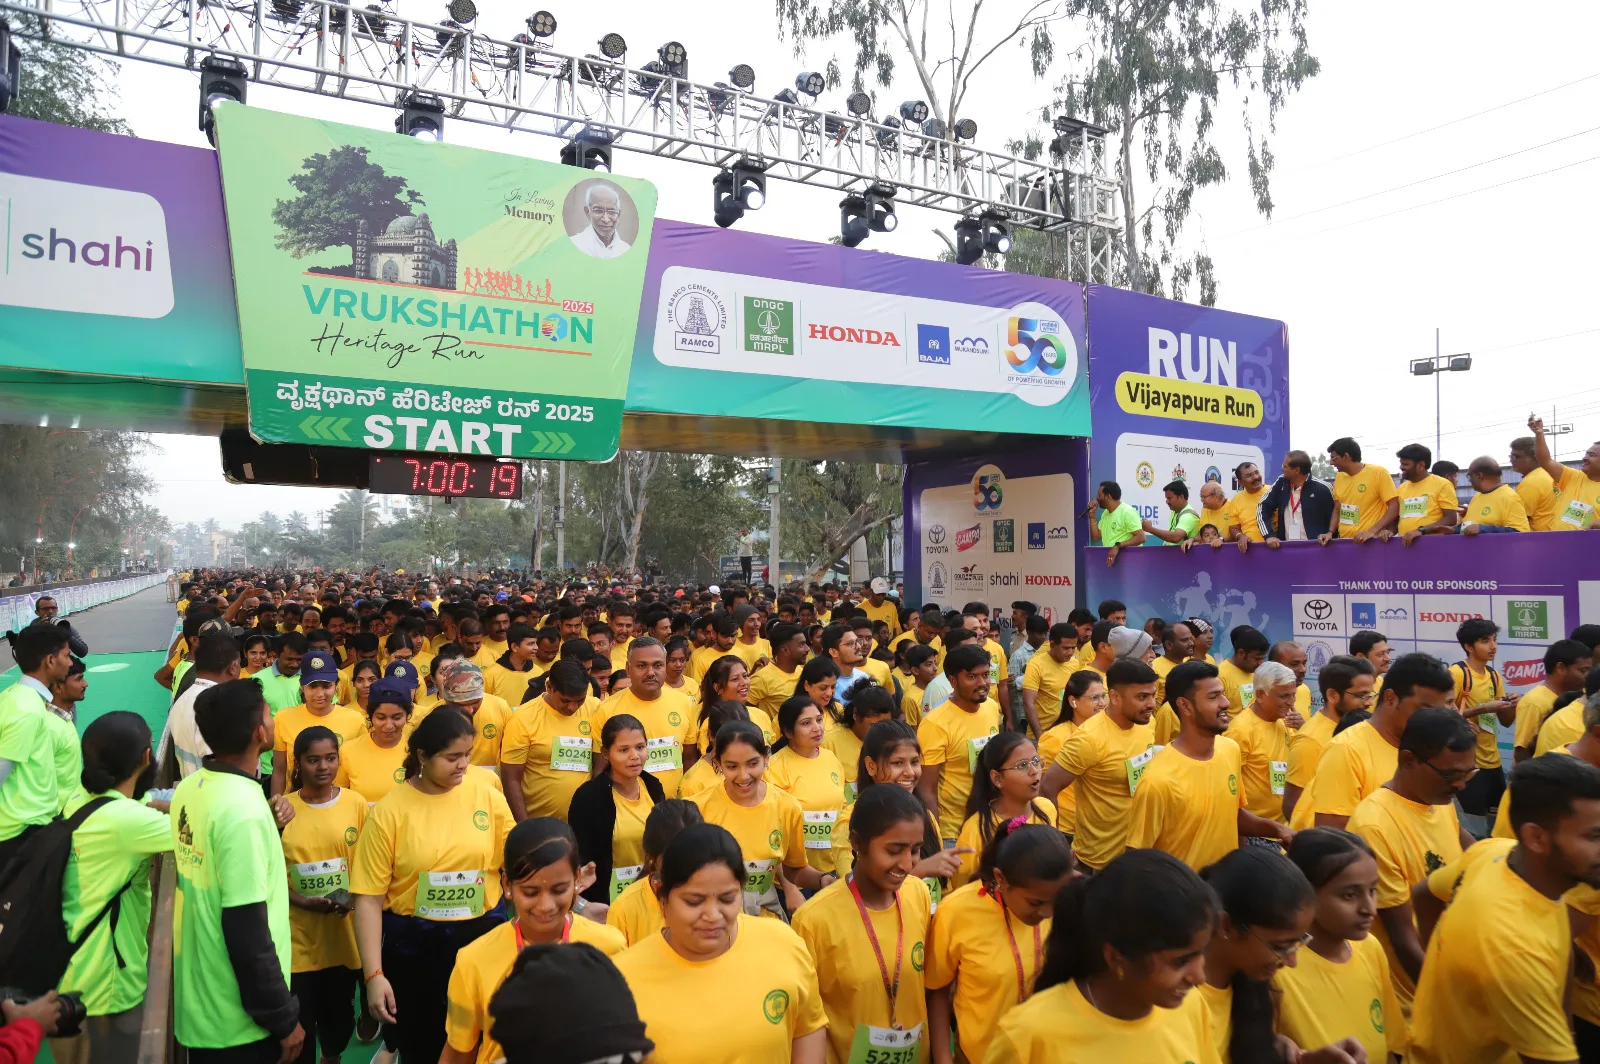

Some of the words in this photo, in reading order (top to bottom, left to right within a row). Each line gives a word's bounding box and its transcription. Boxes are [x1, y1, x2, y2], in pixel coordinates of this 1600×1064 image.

[504, 188, 522, 202] In
[525, 190, 555, 209] Loving
[504, 204, 555, 225] Memory
[22, 227, 154, 272] shahi
[669, 286, 686, 307] RAMCO
[687, 284, 719, 300] CEMENTS
[302, 284, 593, 344] VRUKSHATHON
[563, 300, 593, 314] 2025
[681, 337, 714, 348] RAMCO
[808, 323, 901, 348] HONDA
[311, 322, 421, 368] Heritage
[423, 331, 484, 361] Run
[753, 342, 785, 353] MRPL
[919, 354, 950, 364] BAJAJ
[1148, 326, 1237, 388] RUN
[276, 379, 386, 411] ವೃಕ್ಷಥಾನ್
[392, 387, 492, 415] ಹೆರಿಟೇಜ್
[497, 397, 540, 418] ರನ್
[545, 403, 594, 423] 2025
[1126, 381, 1220, 414] Vijayapura
[1225, 395, 1255, 418] Run
[363, 414, 522, 456] START
[1174, 444, 1206, 456] Supported
[1206, 447, 1215, 457] By
[926, 546, 949, 554] TOYOTA
[990, 572, 1019, 586] shahi
[1025, 575, 1072, 586] HONDA
[1339, 581, 1371, 590] THANK
[1373, 581, 1393, 590] YOU
[1395, 581, 1409, 590] TO
[1411, 581, 1433, 590] OUR
[1436, 580, 1498, 590] SPONSORS
[1300, 622, 1338, 631] TOYOTA
[1506, 661, 1547, 679] CAMP
[558, 748, 591, 760] 50243
[300, 874, 342, 889] 53843
[426, 887, 476, 901] 52220
